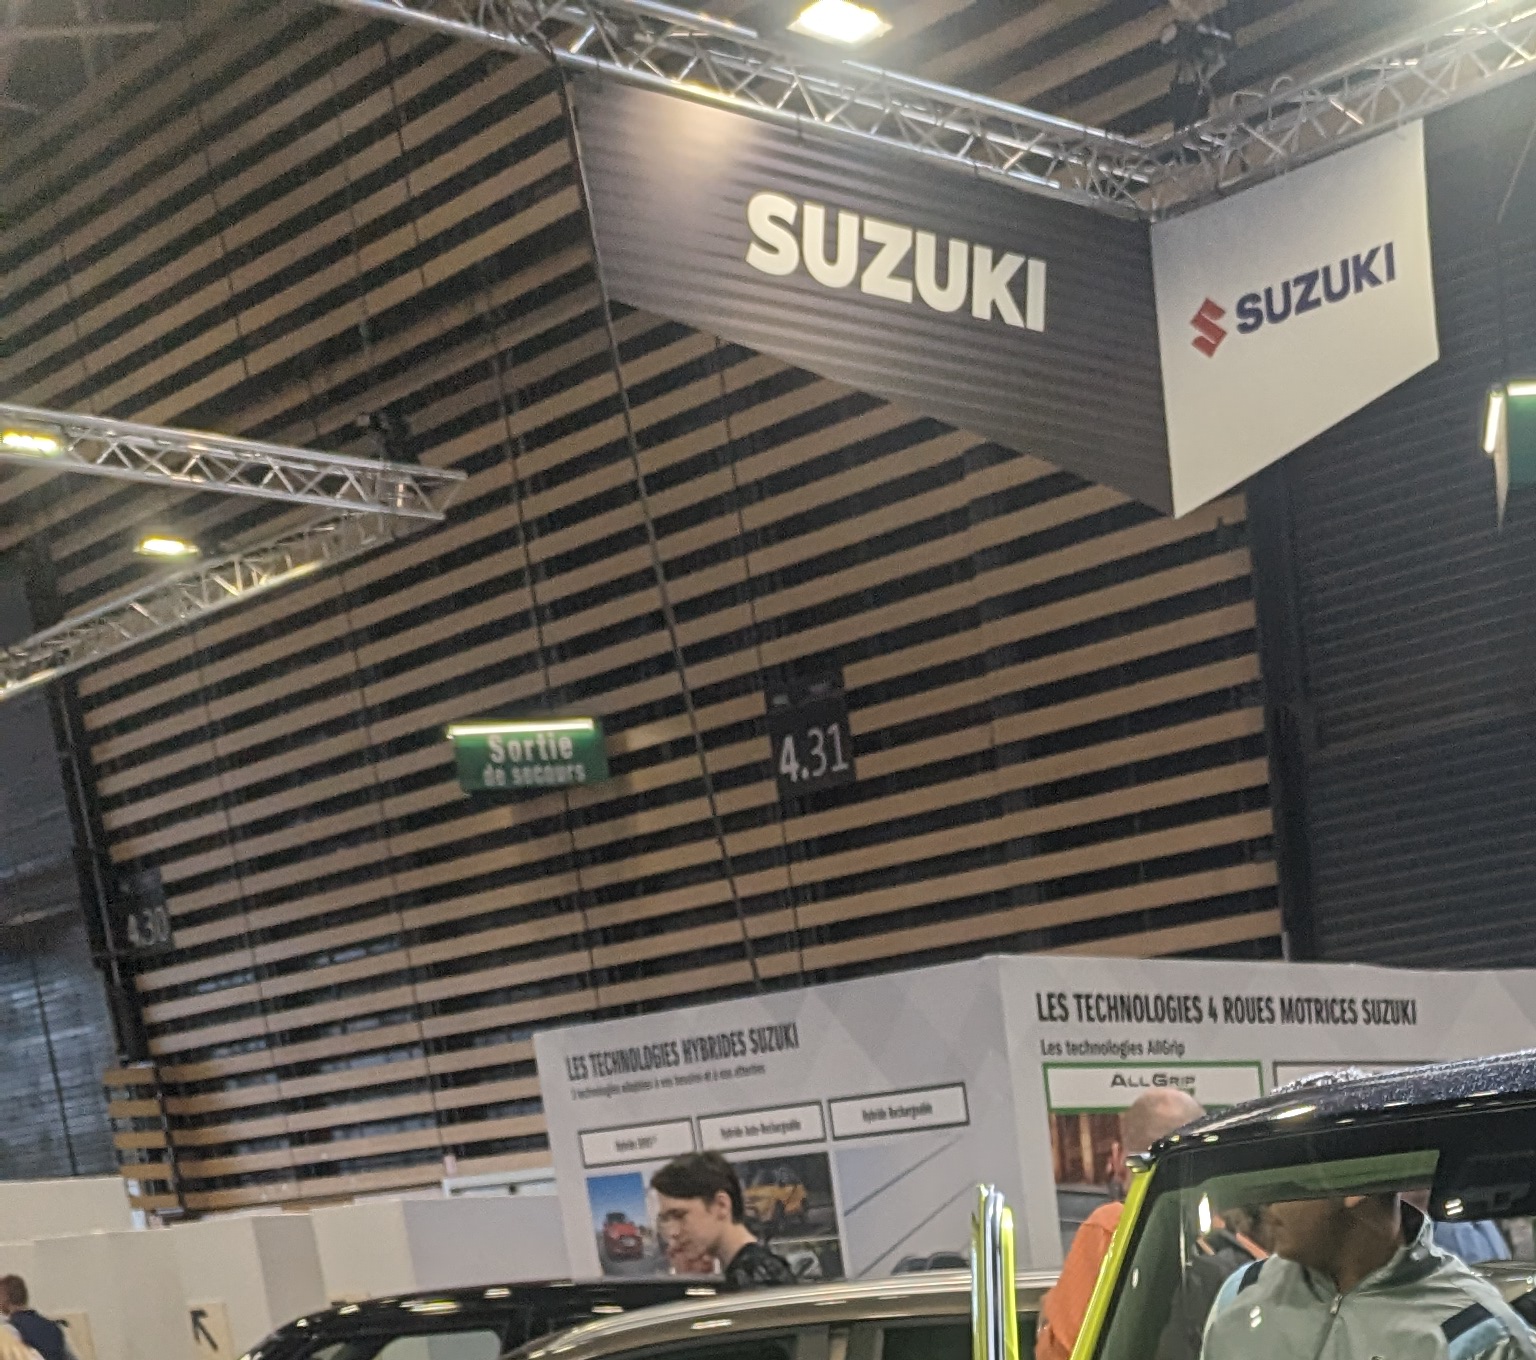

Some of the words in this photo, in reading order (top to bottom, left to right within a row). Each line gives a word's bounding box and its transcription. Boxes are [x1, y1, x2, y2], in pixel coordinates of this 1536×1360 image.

[746, 191, 1046, 333] SUZUKI
[1236, 241, 1396, 335] SUZUKI
[488, 732, 573, 763] Sortie
[780, 722, 849, 783] 4.31
[1036, 992, 1070, 1023] LES
[1072, 993, 1203, 1024] TECHNOLOGIES
[1208, 996, 1218, 1024] 4
[1222, 996, 1276, 1025] ROUES
[1280, 996, 1358, 1025] MOTRICES
[1362, 998, 1417, 1025] SUZUKI
[567, 1054, 588, 1081] LES
[588, 1040, 680, 1078] TECHNOLOGIES
[681, 1030, 747, 1064] HYBRIDES
[748, 1022, 800, 1056] SUZUKI
[1040, 1039, 1063, 1056] Les
[1065, 1039, 1144, 1059] technologies
